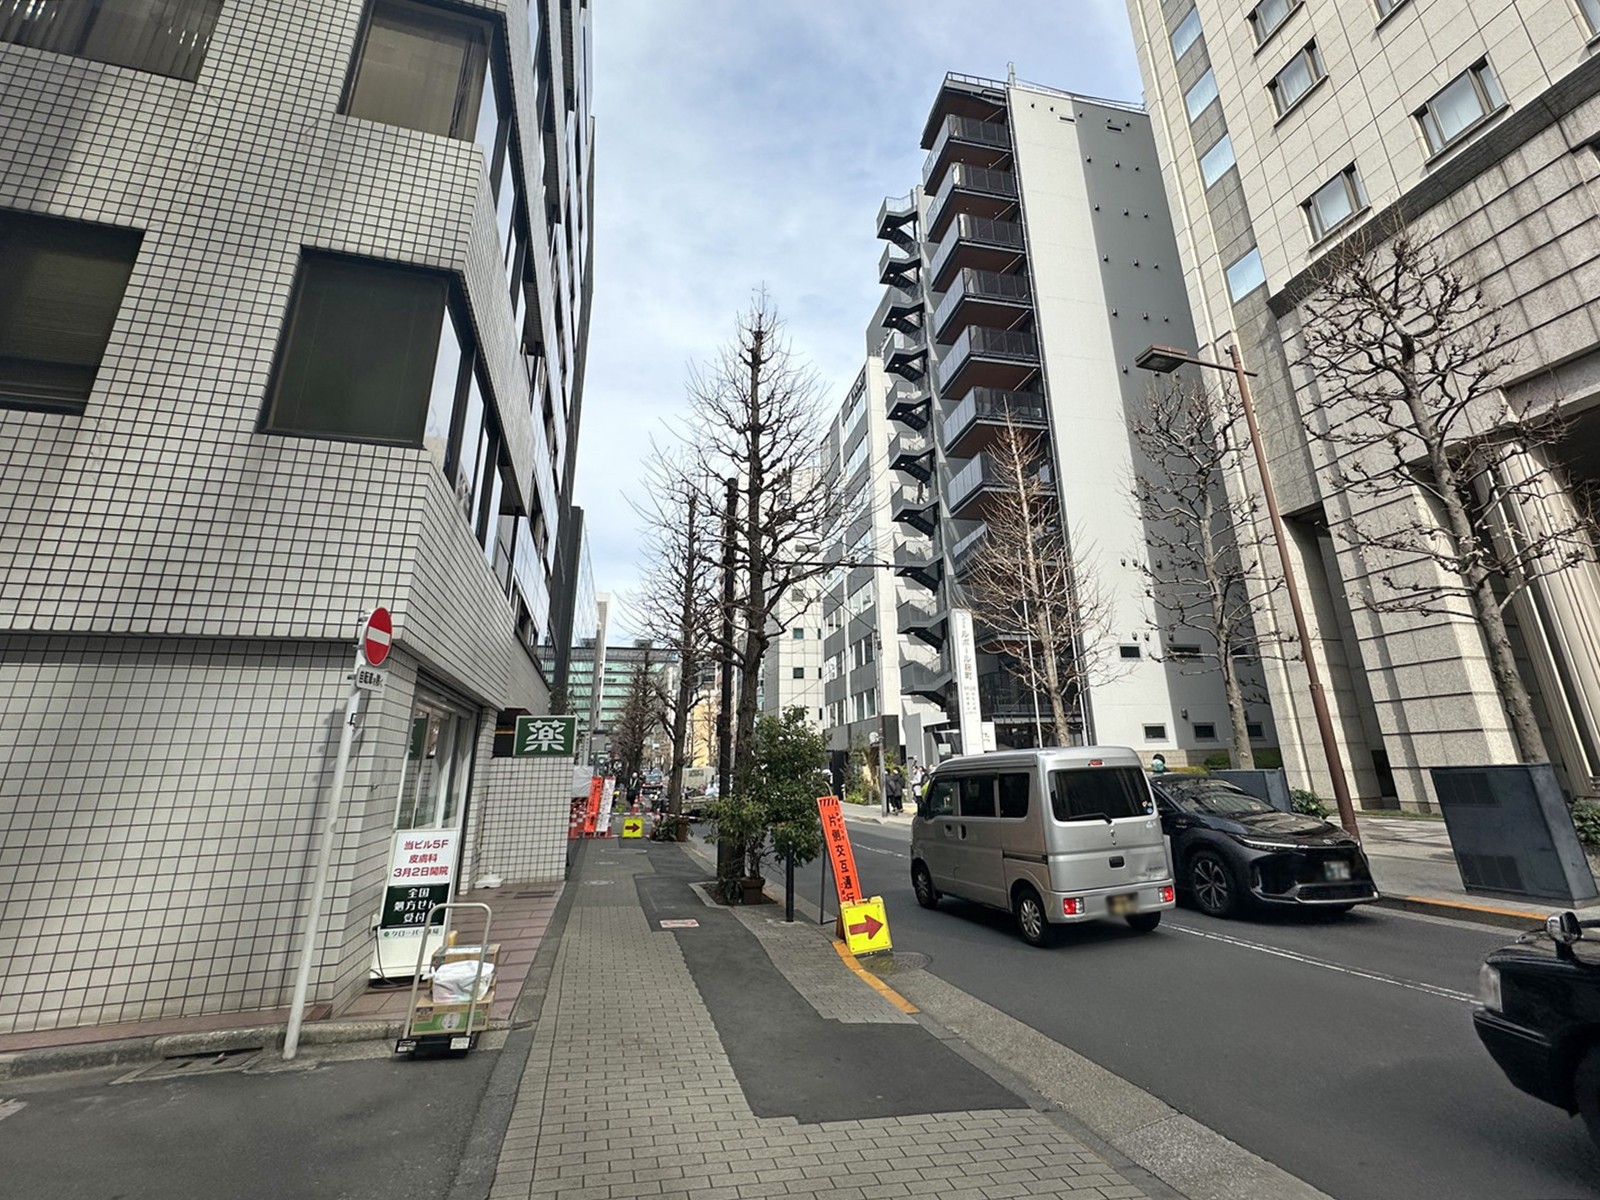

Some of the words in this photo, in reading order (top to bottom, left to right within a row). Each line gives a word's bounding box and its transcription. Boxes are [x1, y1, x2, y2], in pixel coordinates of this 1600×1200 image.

[523, 719, 566, 752] 薬
[404, 839, 449, 850] 当ビル5F
[408, 853, 438, 863] 皮膚科
[408, 887, 430, 899] 全国
[403, 912, 426, 923] 受付
